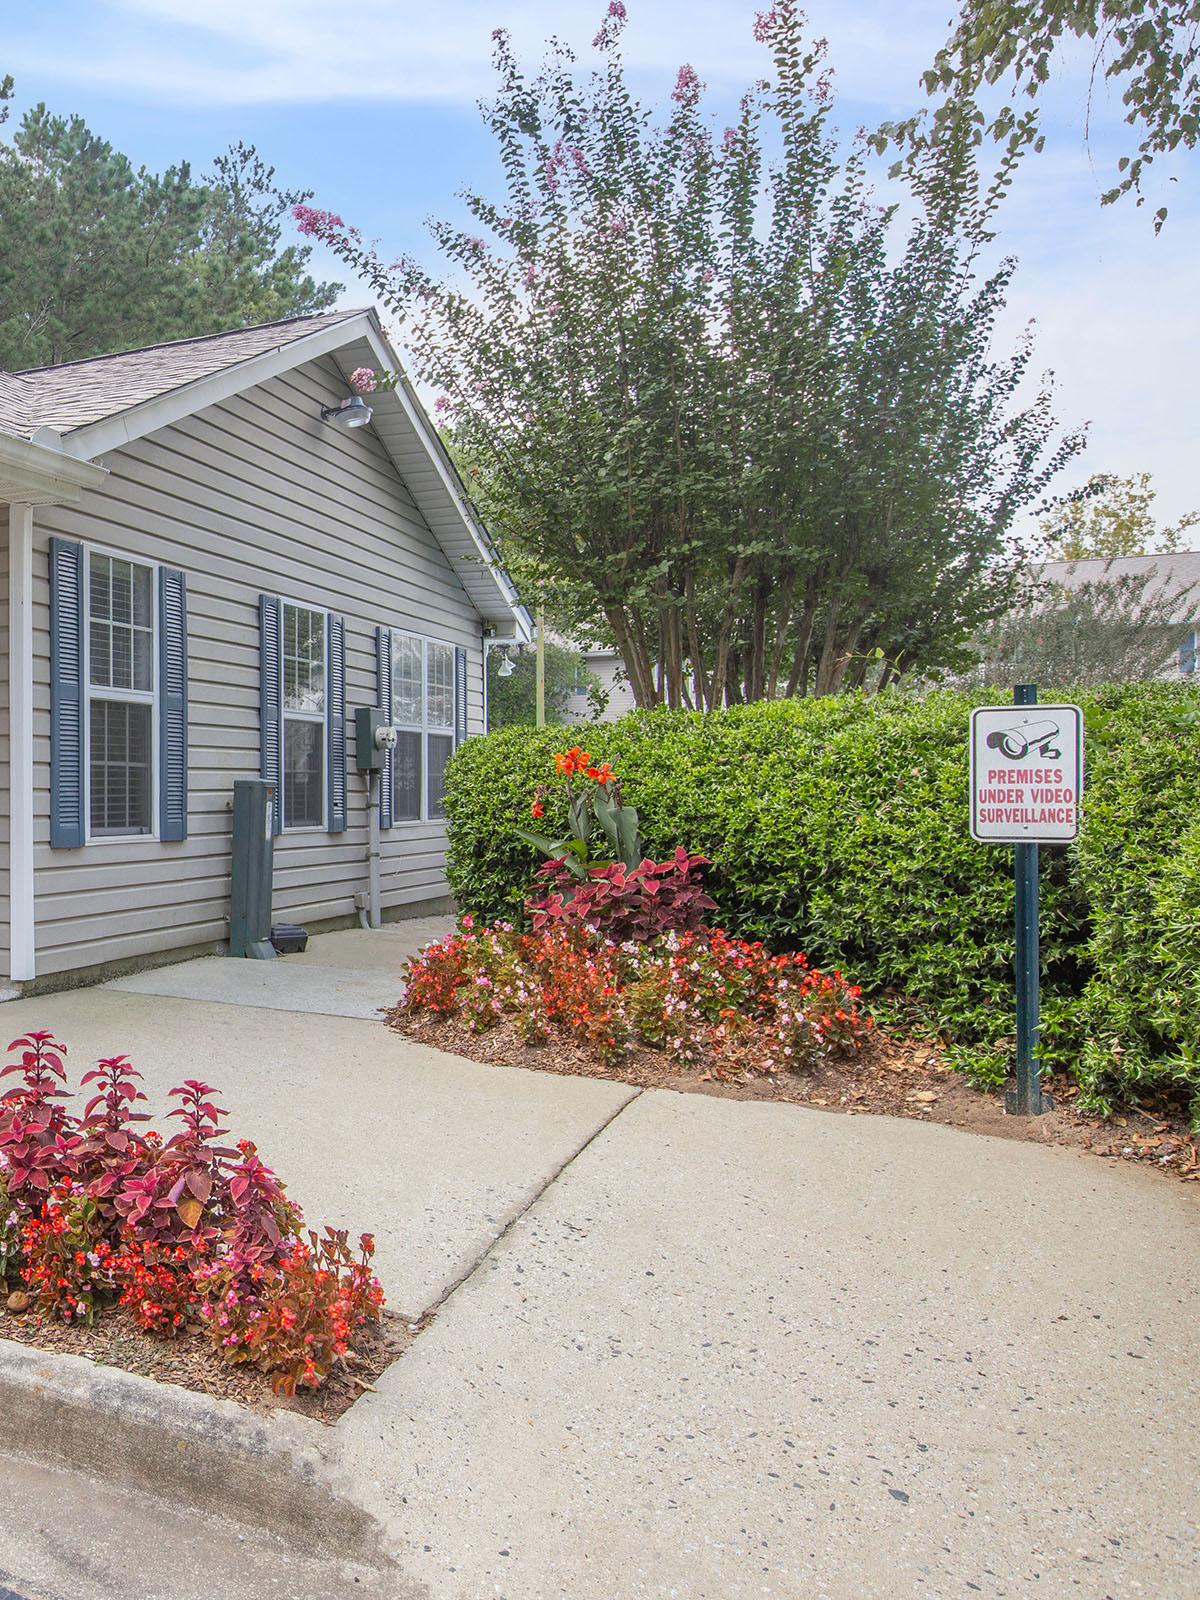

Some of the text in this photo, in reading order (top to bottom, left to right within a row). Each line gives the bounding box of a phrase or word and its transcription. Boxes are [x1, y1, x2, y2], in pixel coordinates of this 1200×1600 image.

[988, 769, 1063, 784] PREMISES
[979, 788, 1073, 804] UNDER VIDEO
[979, 808, 1073, 824] SURVEILLANCE
